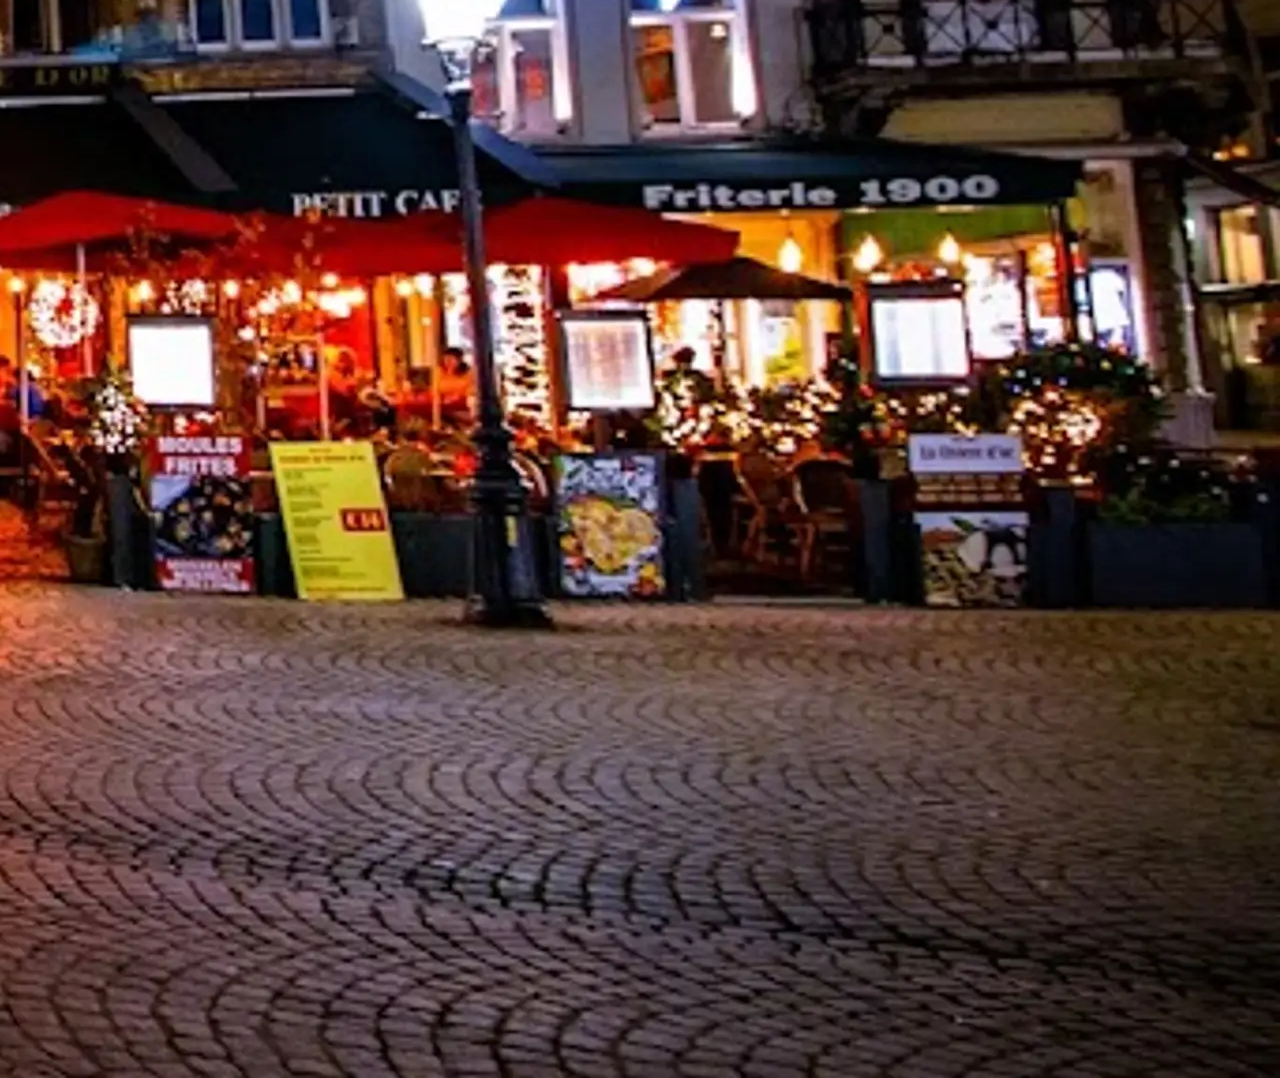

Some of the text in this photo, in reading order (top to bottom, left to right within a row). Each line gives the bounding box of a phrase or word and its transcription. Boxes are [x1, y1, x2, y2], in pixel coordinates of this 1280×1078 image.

[291, 188, 482, 219] PETIT CAF
[642, 174, 1000, 210] Friterie 1900
[158, 436, 244, 454] MOULES
[164, 455, 237, 474] FRITES
